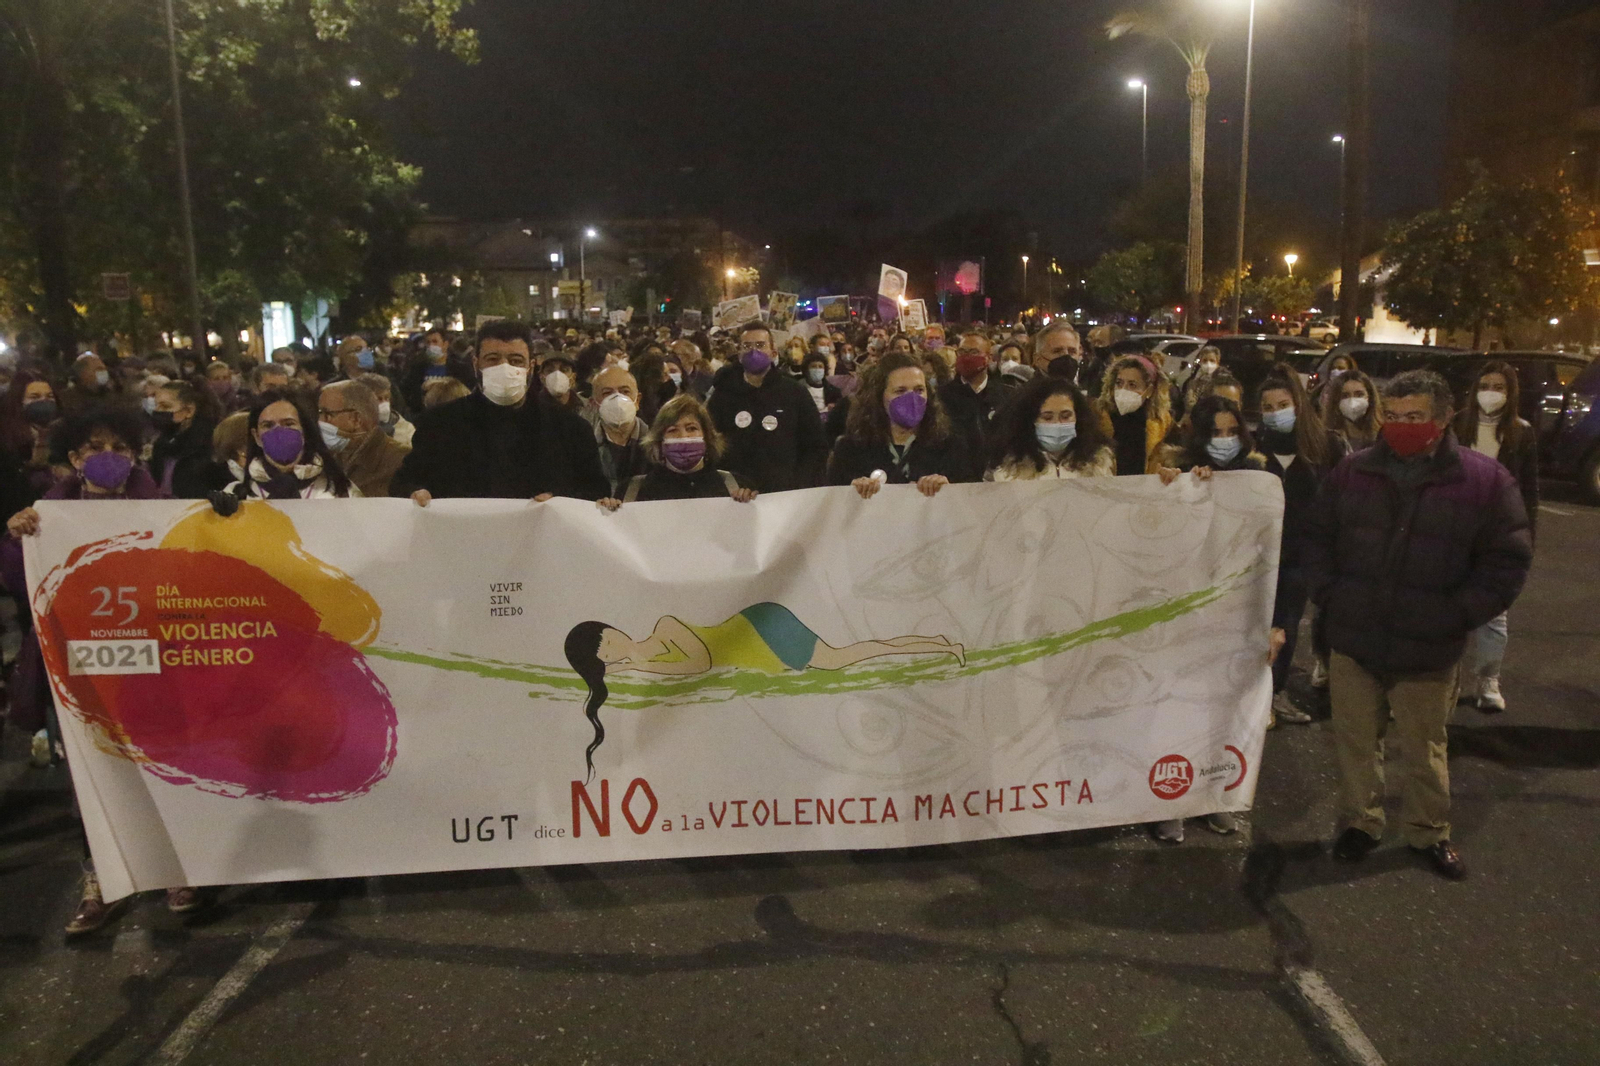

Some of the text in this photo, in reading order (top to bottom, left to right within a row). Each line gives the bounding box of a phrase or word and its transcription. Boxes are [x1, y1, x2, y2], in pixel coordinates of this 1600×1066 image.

[156, 582, 180, 597] DÍA
[490, 582, 524, 593] VIVIR
[90, 585, 140, 626] 25
[156, 596, 267, 610] INTERNACIONAL
[490, 595, 511, 605] SIN
[490, 607, 524, 617] MIEDO
[90, 628, 149, 638] NOVIEMBRE
[159, 621, 278, 641] VIOLENCIA
[75, 644, 154, 669] 2021
[162, 644, 255, 667] GÉNERO
[1153, 761, 1189, 782] UGT
[451, 777, 1094, 843] UGT dice NO a la VIOLENCIA MACHISTA
